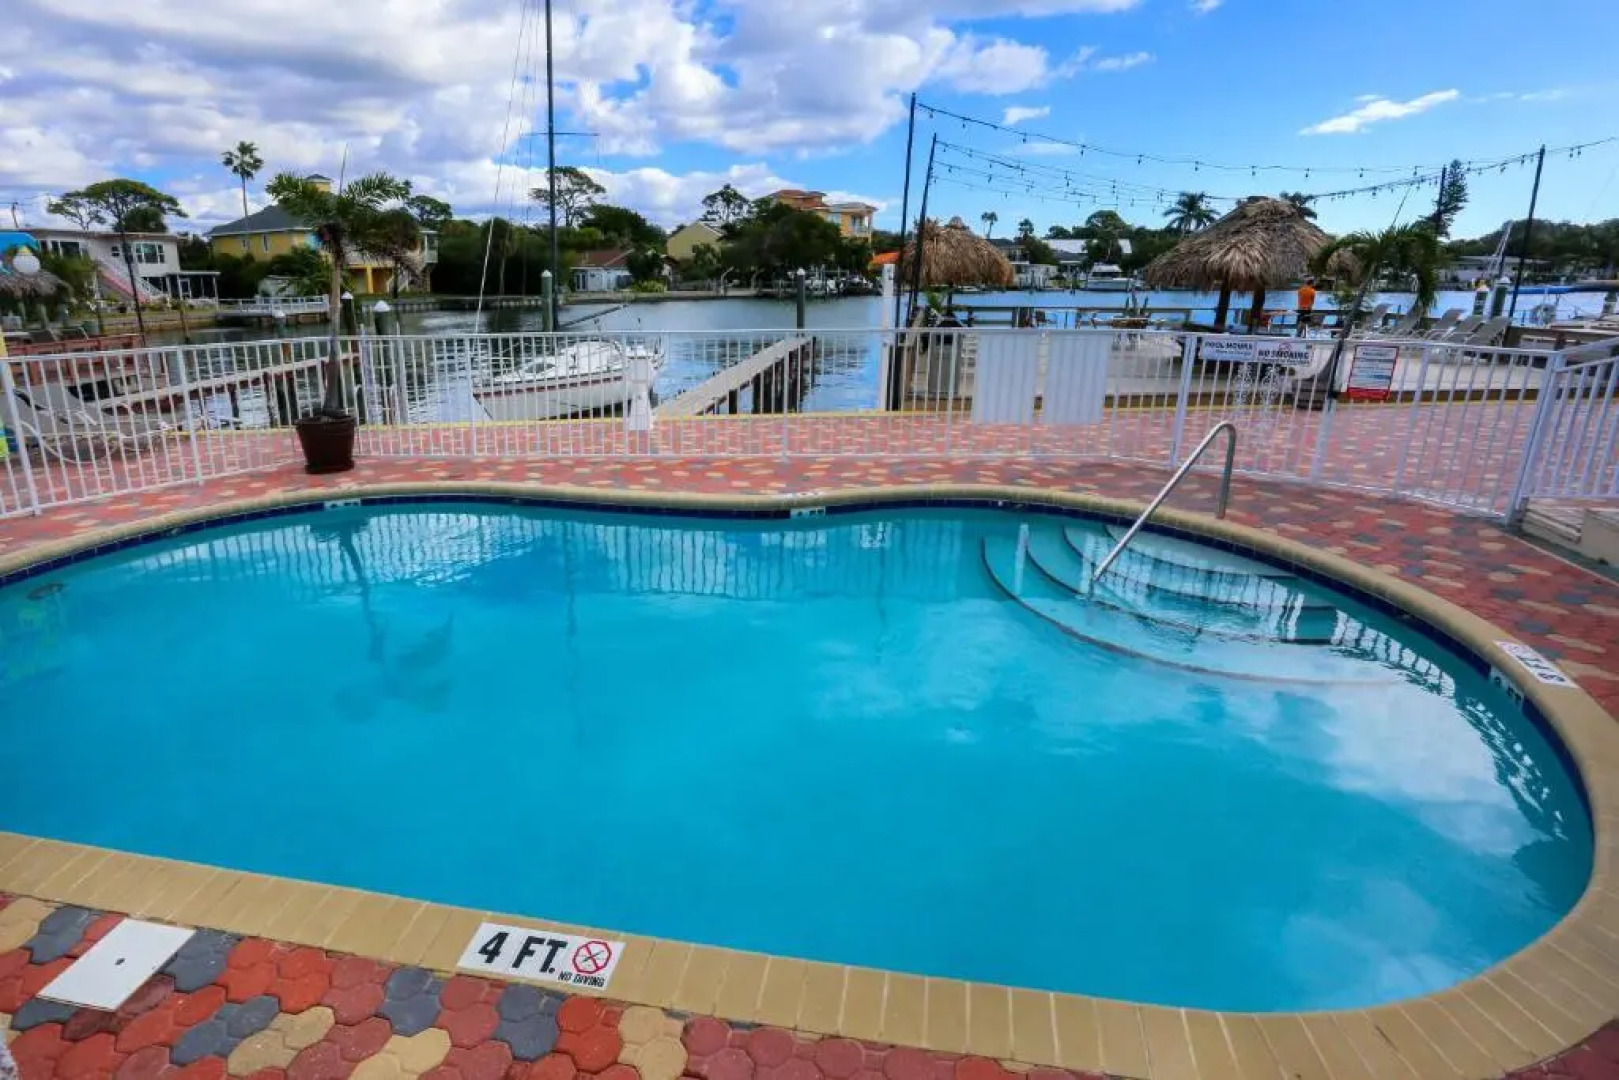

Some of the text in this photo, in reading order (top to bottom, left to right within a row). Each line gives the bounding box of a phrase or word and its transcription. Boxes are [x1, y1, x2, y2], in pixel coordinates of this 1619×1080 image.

[1271, 351, 1309, 360] SMOKING
[478, 932, 568, 973] 4 FT.
[558, 970, 606, 987] NO DIVING
